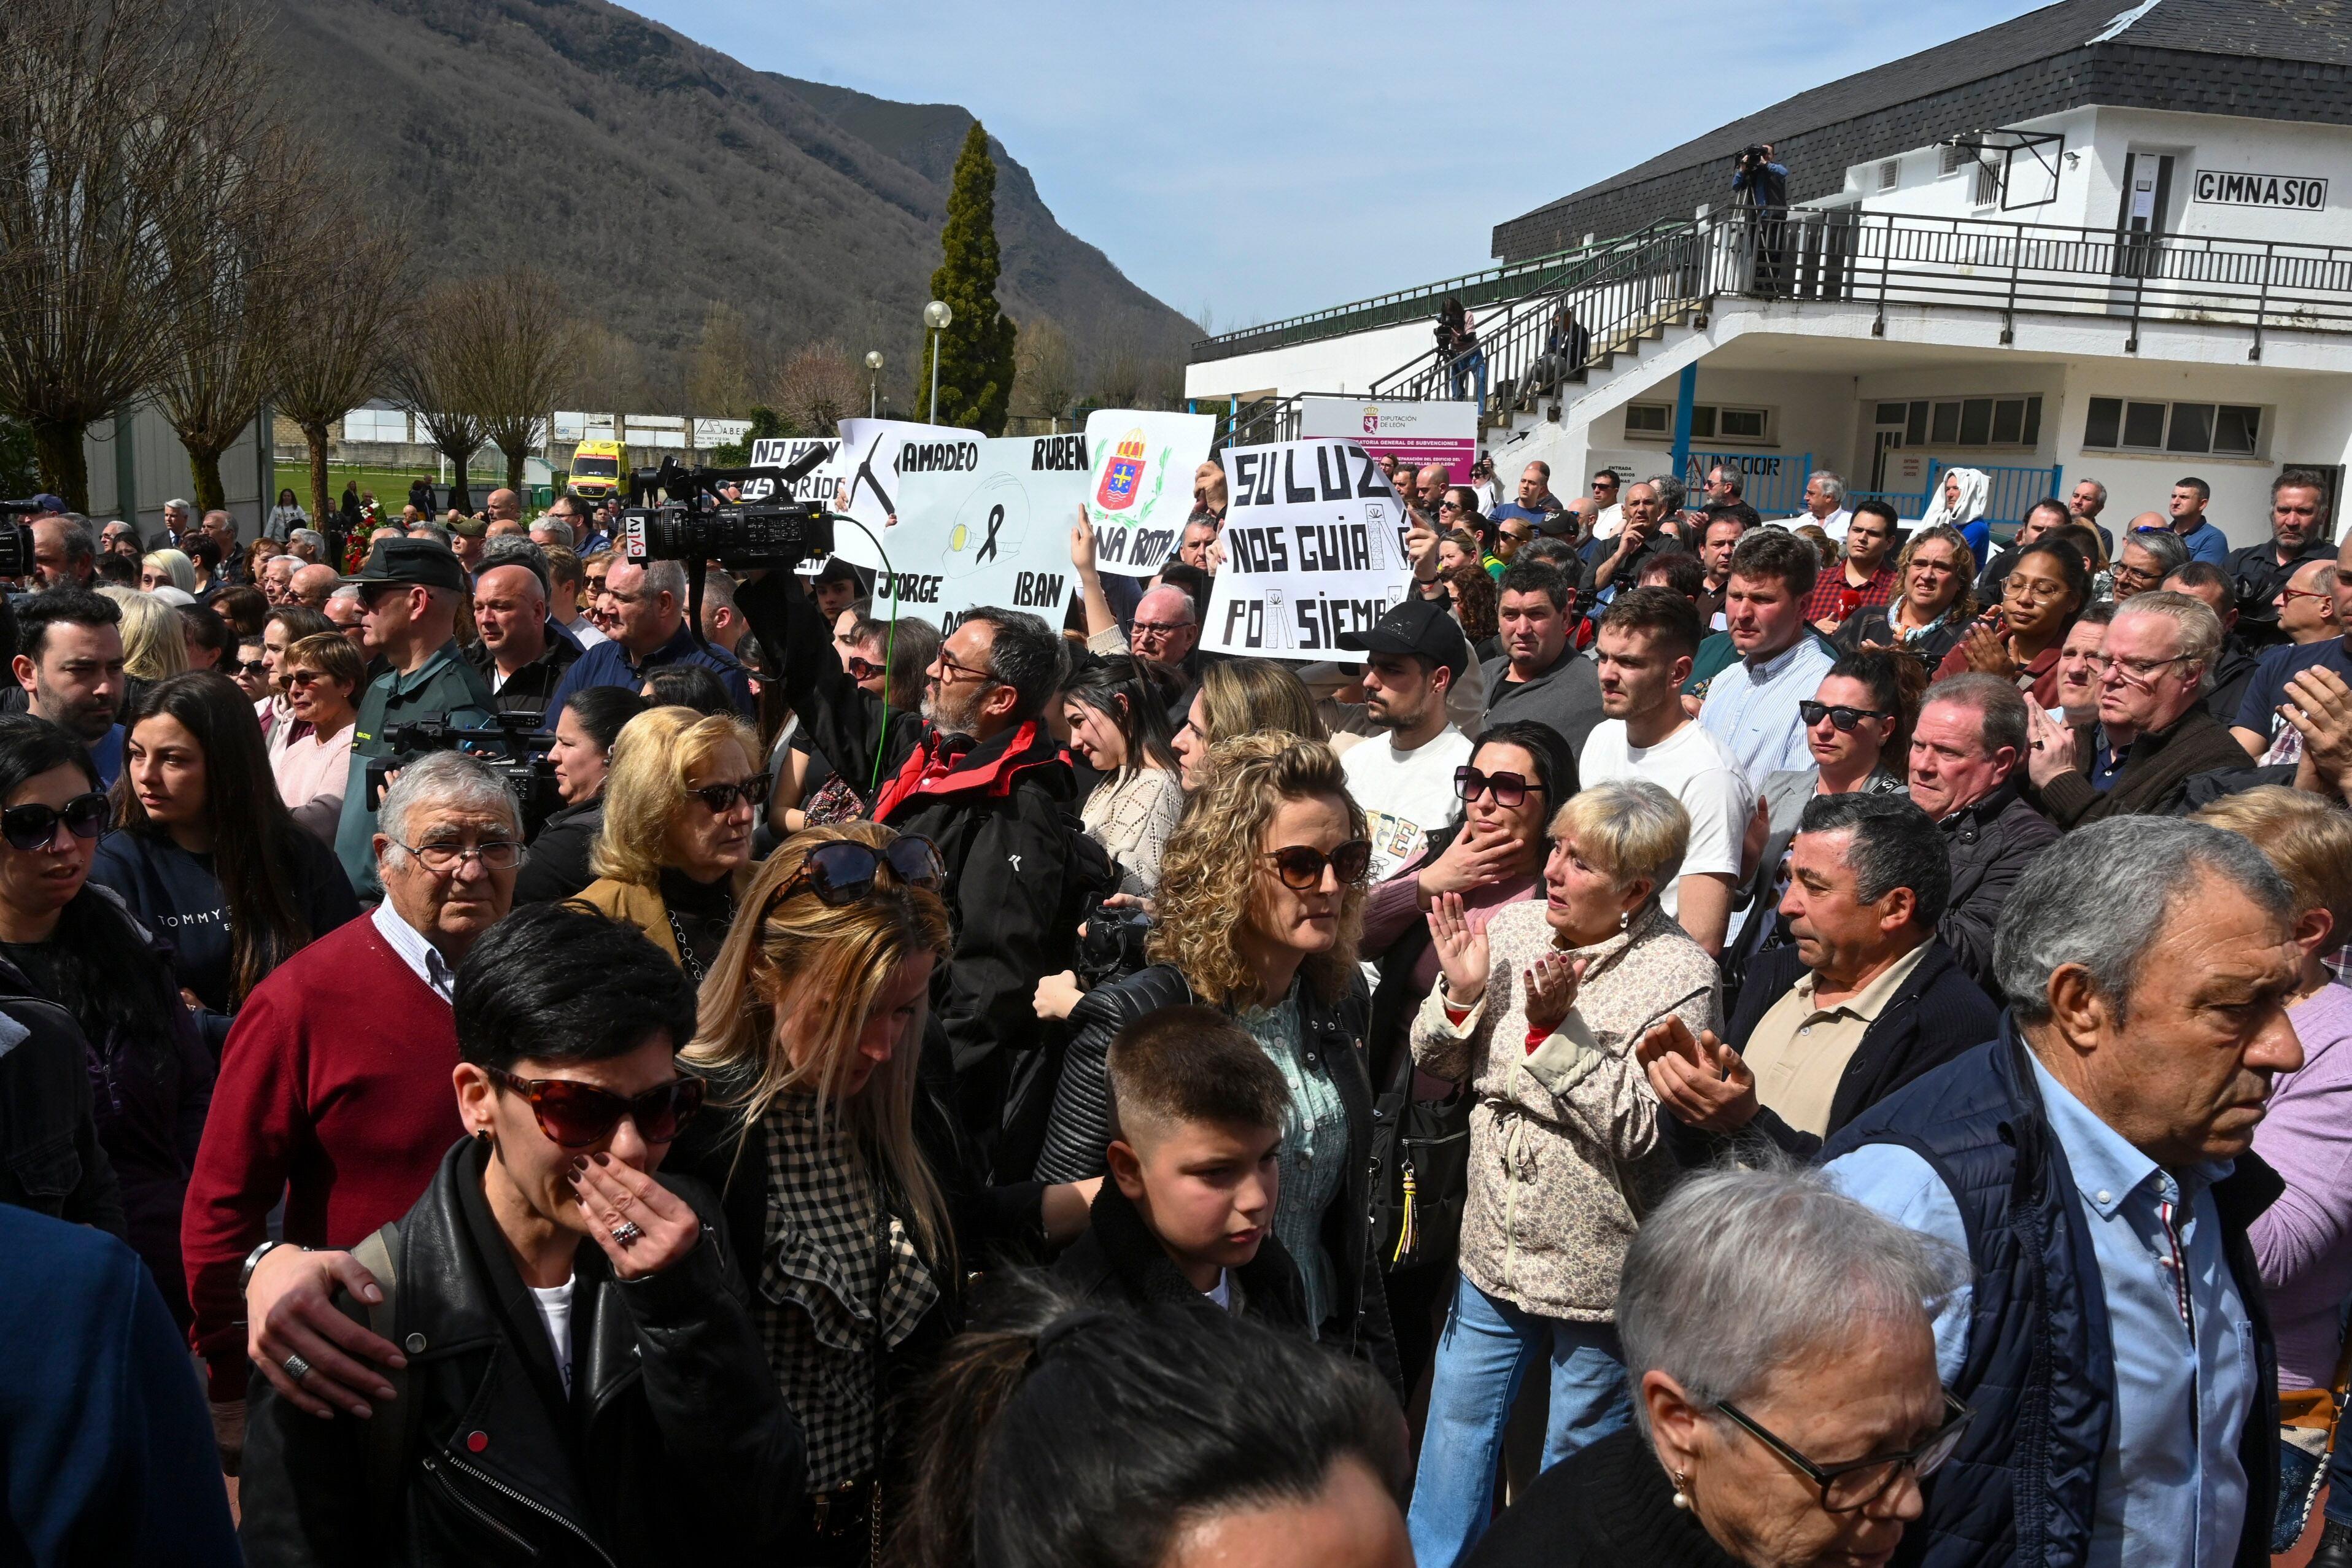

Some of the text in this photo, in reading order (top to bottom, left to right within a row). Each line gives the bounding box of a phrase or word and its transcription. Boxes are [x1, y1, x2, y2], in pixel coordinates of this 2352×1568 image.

[2199, 174, 2323, 208] GIMNASIO
[754, 441, 841, 463] NO HY
[902, 442, 978, 473] AMADEO
[1031, 435, 1089, 471] RUBEN
[1711, 455, 1779, 476] INOOR
[1234, 445, 1393, 506] SU LUZ
[627, 519, 645, 556] cyltv
[1128, 528, 1175, 566] ROTA
[1229, 527, 1288, 573] NOS
[878, 571, 943, 603] JORGE
[1013, 571, 1064, 608] IBAN
[158, 909, 220, 927] TOMMY
